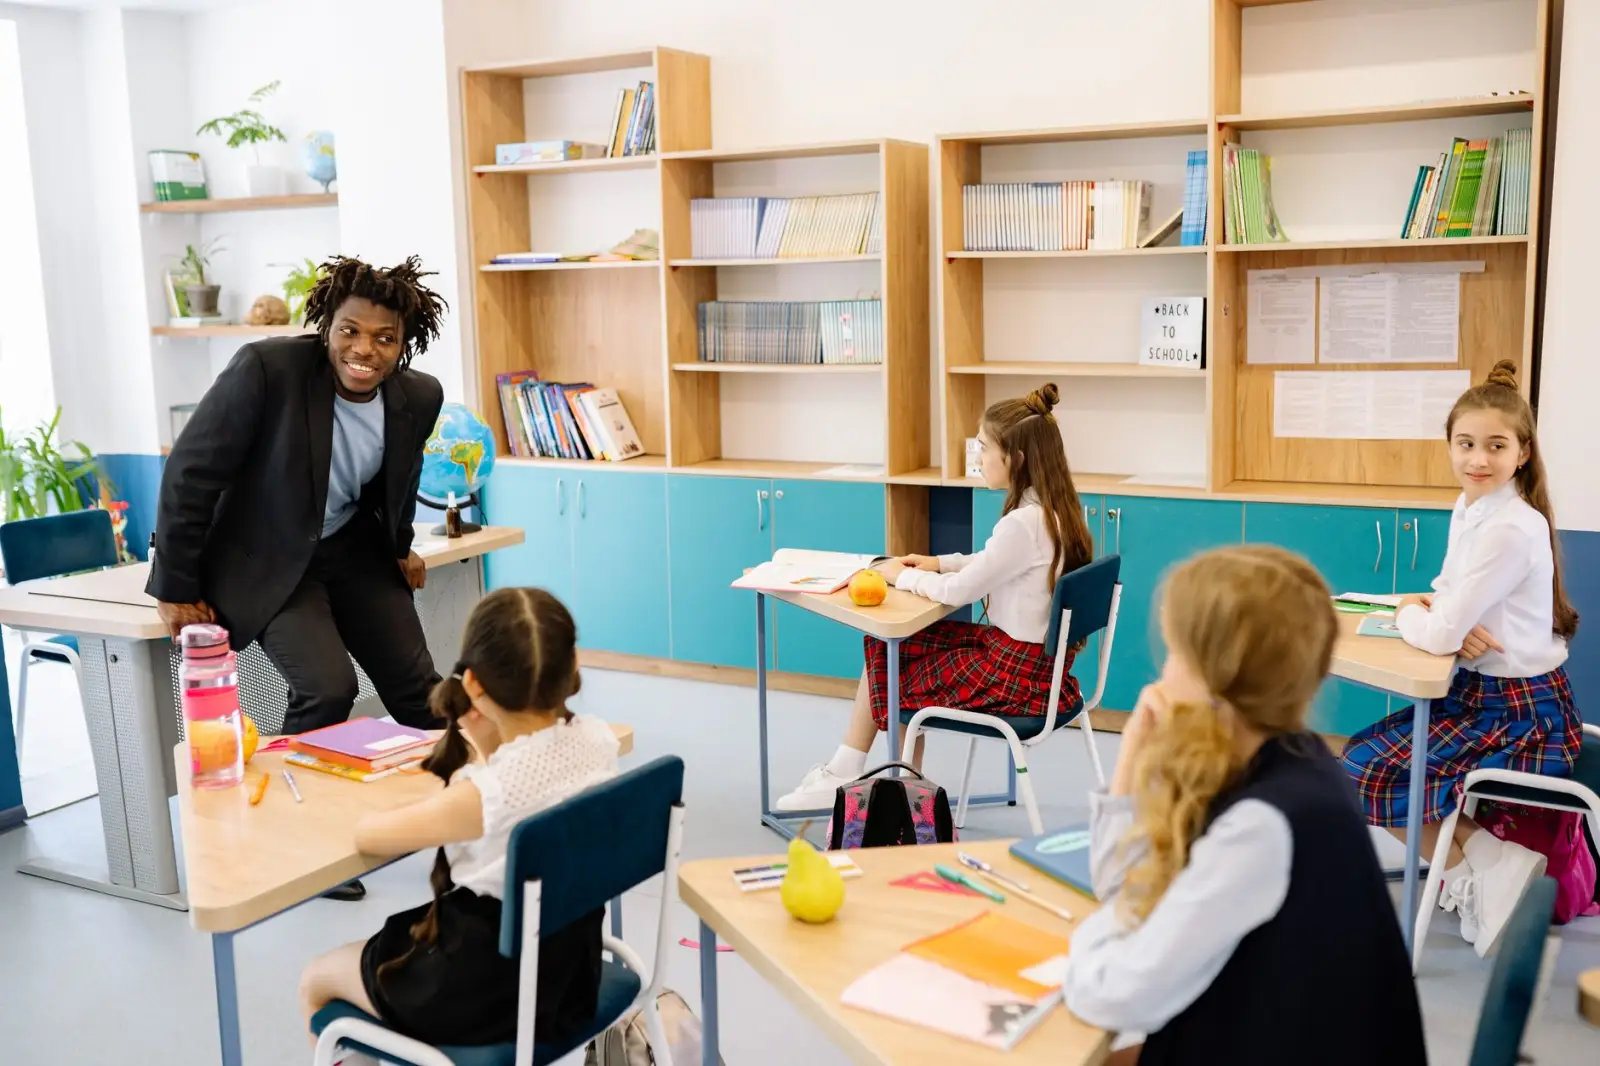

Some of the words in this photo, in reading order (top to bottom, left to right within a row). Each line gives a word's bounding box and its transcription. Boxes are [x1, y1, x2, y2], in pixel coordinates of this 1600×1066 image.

[1161, 303, 1190, 316] BACK
[1162, 325, 1176, 339] TO
[1148, 347, 1191, 361] SCHOOL
